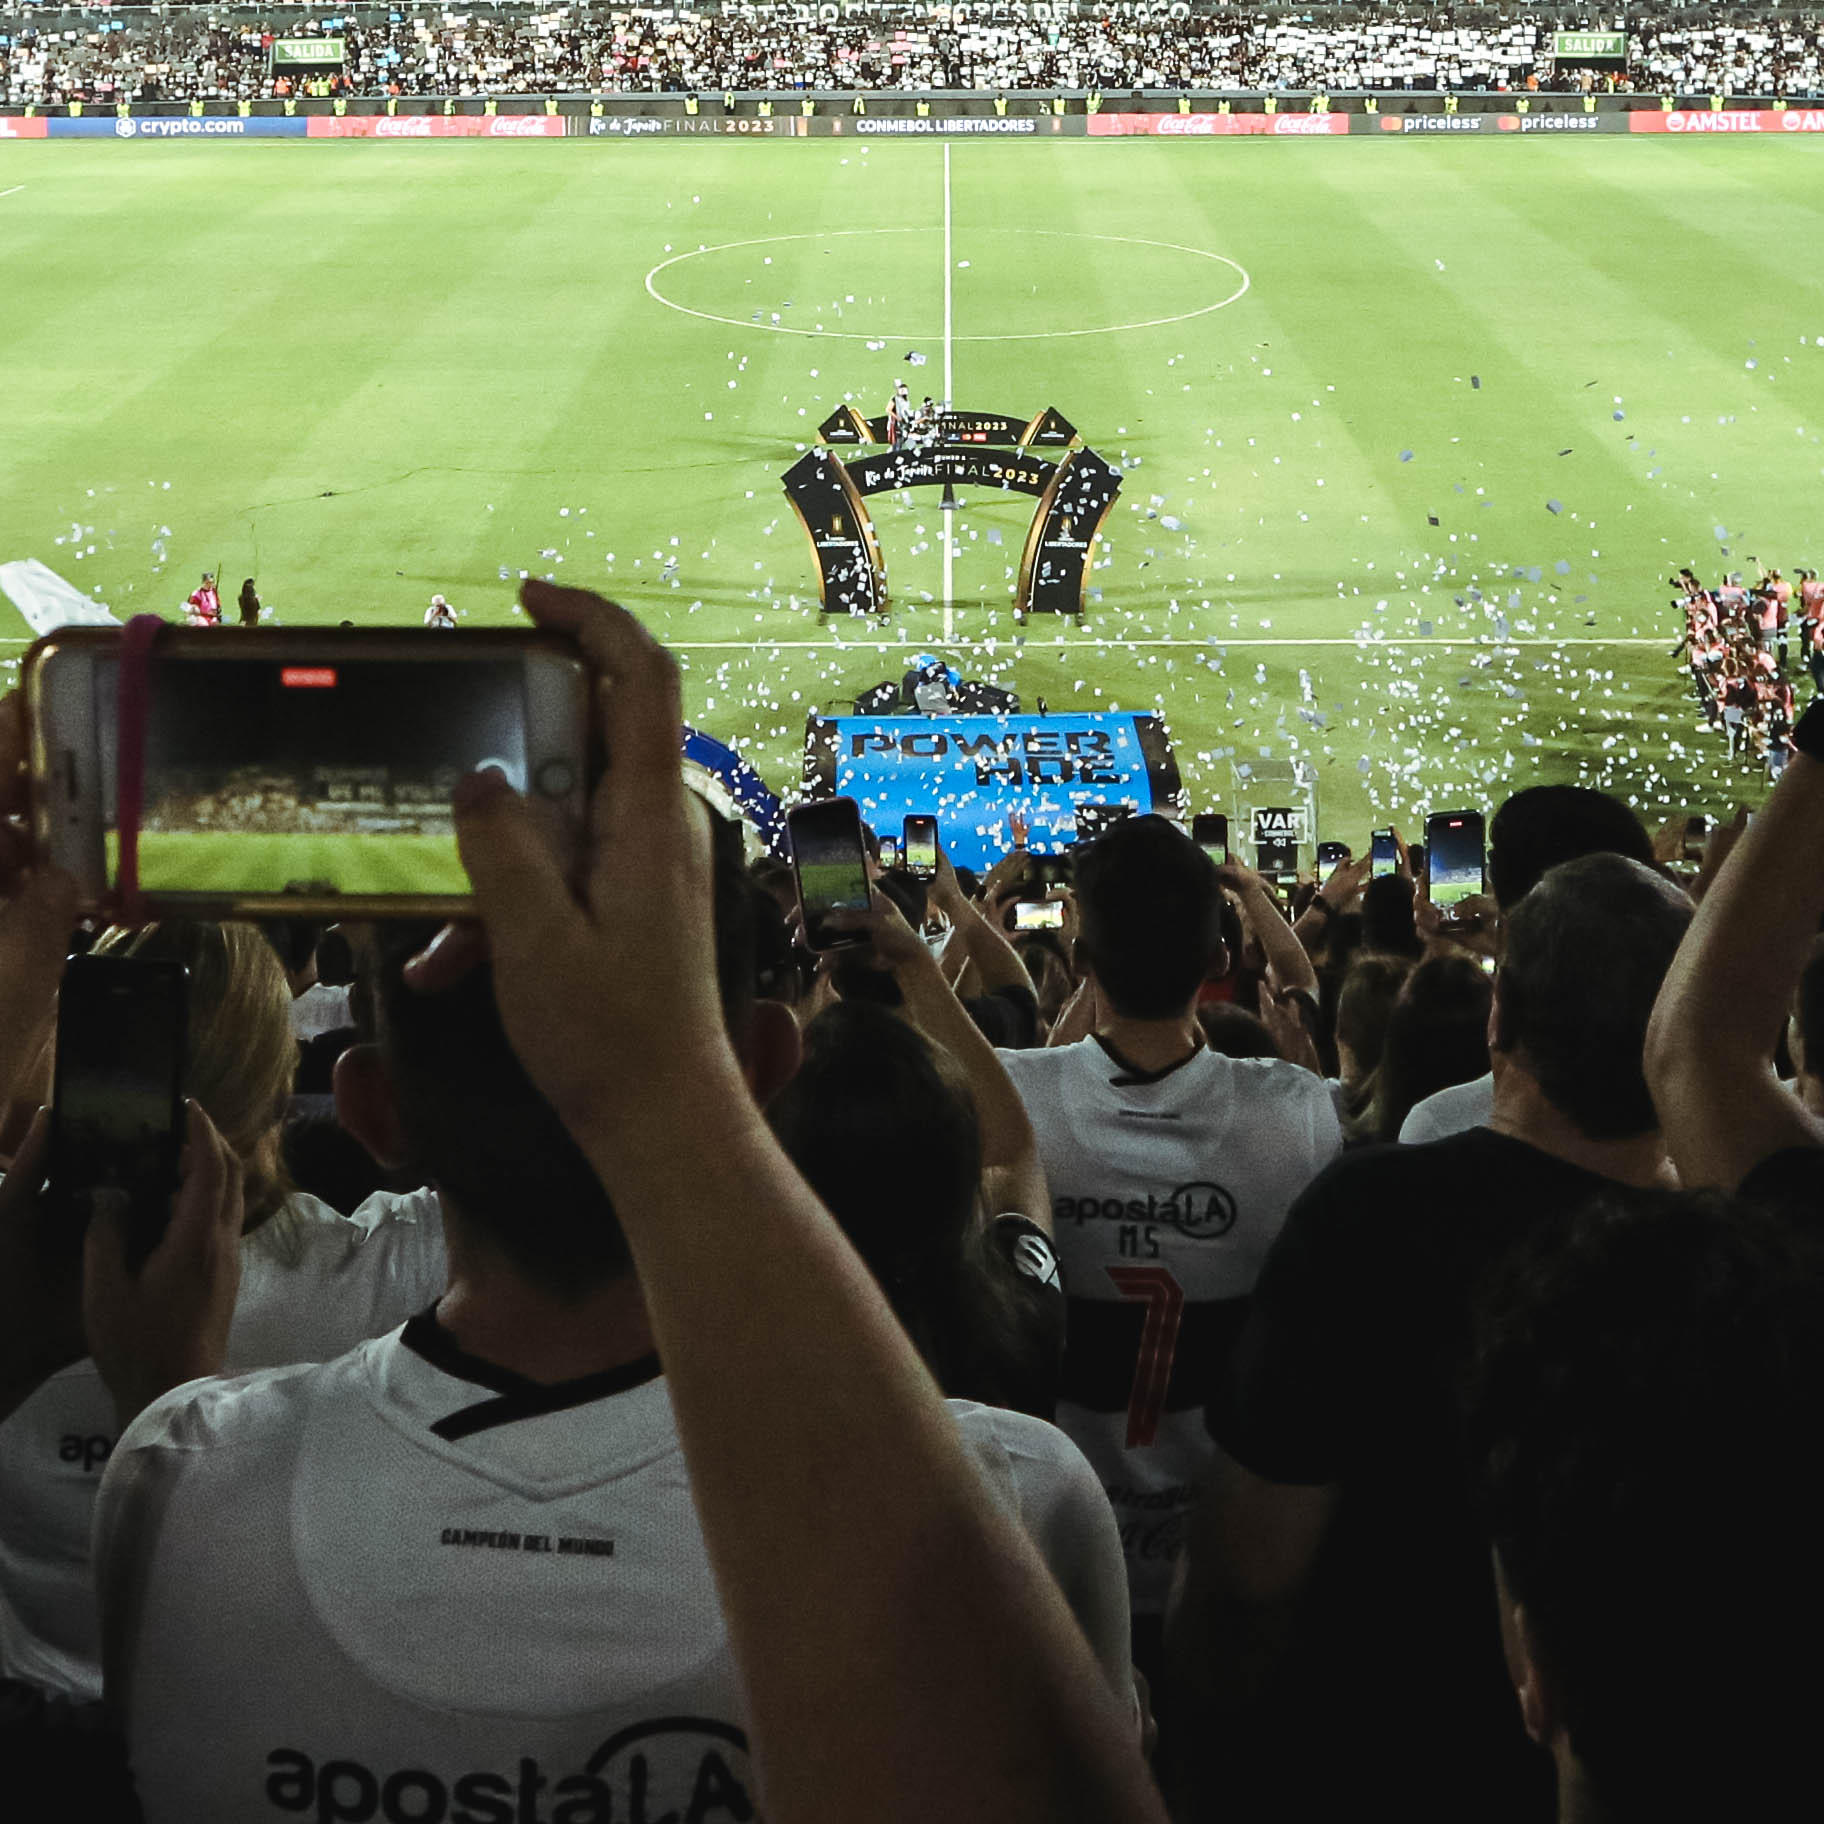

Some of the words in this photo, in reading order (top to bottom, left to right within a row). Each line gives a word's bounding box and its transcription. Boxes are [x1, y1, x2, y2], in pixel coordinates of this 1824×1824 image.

[284, 43, 335, 58] SALIDA
[1564, 38, 1615, 53] SALIDA
[141, 117, 244, 136] crypto.com
[664, 119, 721, 133] FINAL
[725, 119, 774, 133] 2023
[856, 119, 934, 133] CONMEBOL
[935, 119, 1036, 133] LIBERTADORES
[1404, 115, 1479, 132] priceless
[1521, 115, 1597, 132] priceless
[1685, 112, 1761, 130] AMSTEL
[975, 422, 1007, 431] 2023
[993, 466, 1039, 485] 2023
[852, 731, 1112, 758] POWER
[1258, 813, 1301, 829] VAR
[1104, 1266, 1184, 1450] 7
